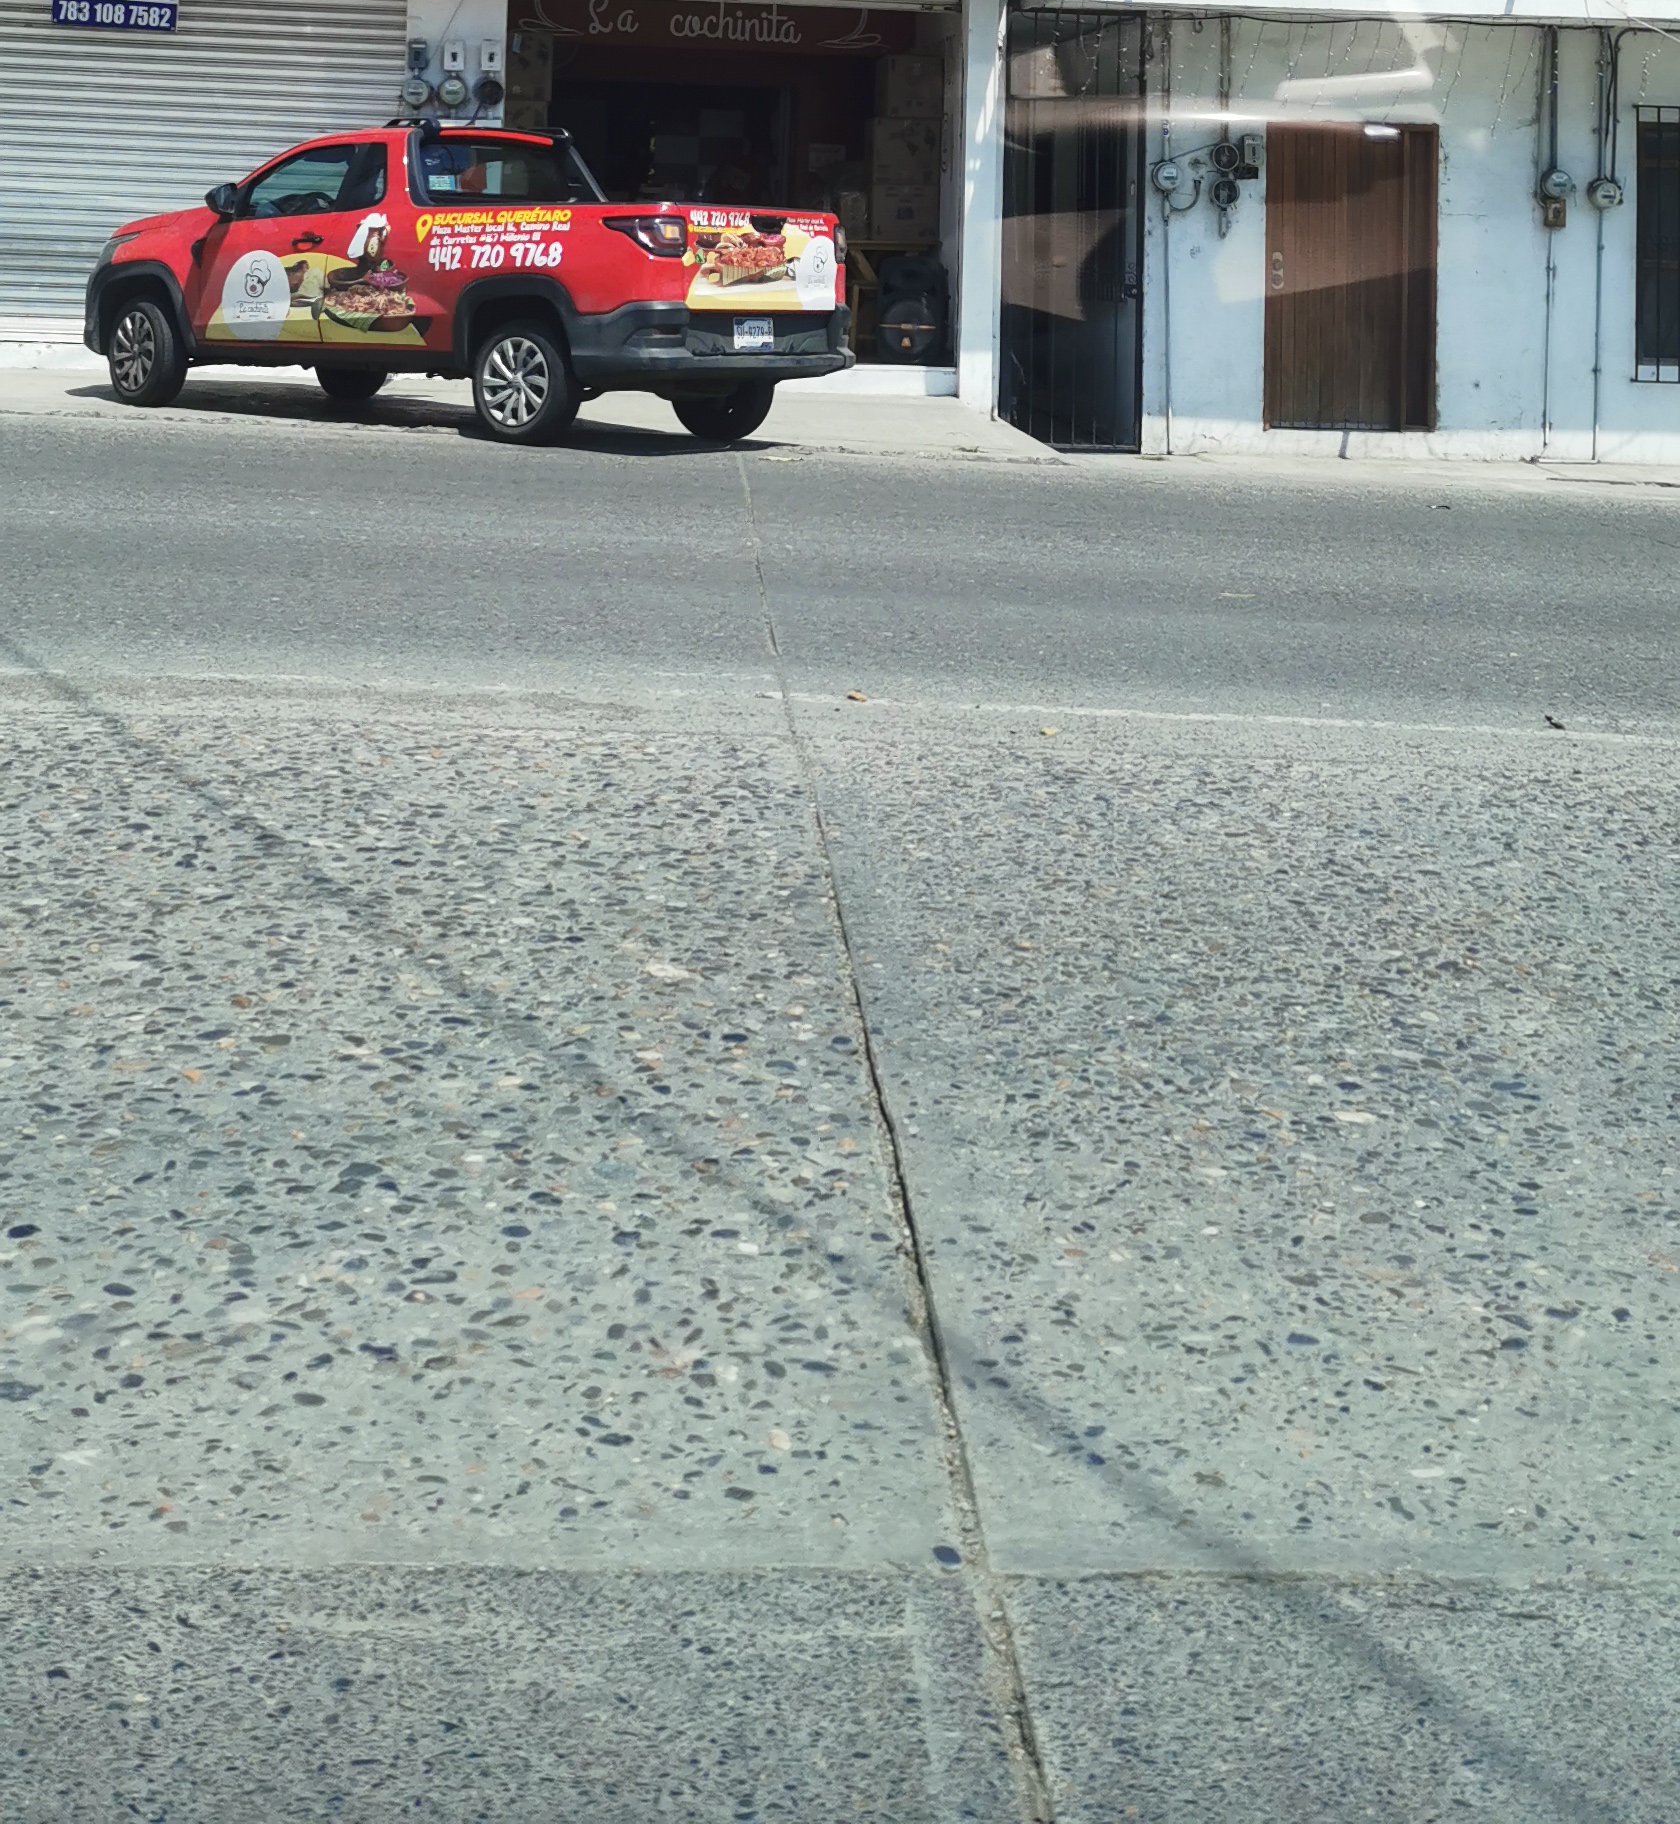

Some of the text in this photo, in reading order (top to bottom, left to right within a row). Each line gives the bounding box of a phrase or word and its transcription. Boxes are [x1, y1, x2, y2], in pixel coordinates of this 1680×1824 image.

[58, 0, 172, 28] 783 108 7582
[670, 0, 801, 43] cochinita
[434, 206, 572, 225] SUCURSAL QUERÉTARO
[690, 210, 709, 225] 442
[710, 211, 727, 226] 720
[428, 241, 563, 271] 442 720 9768
